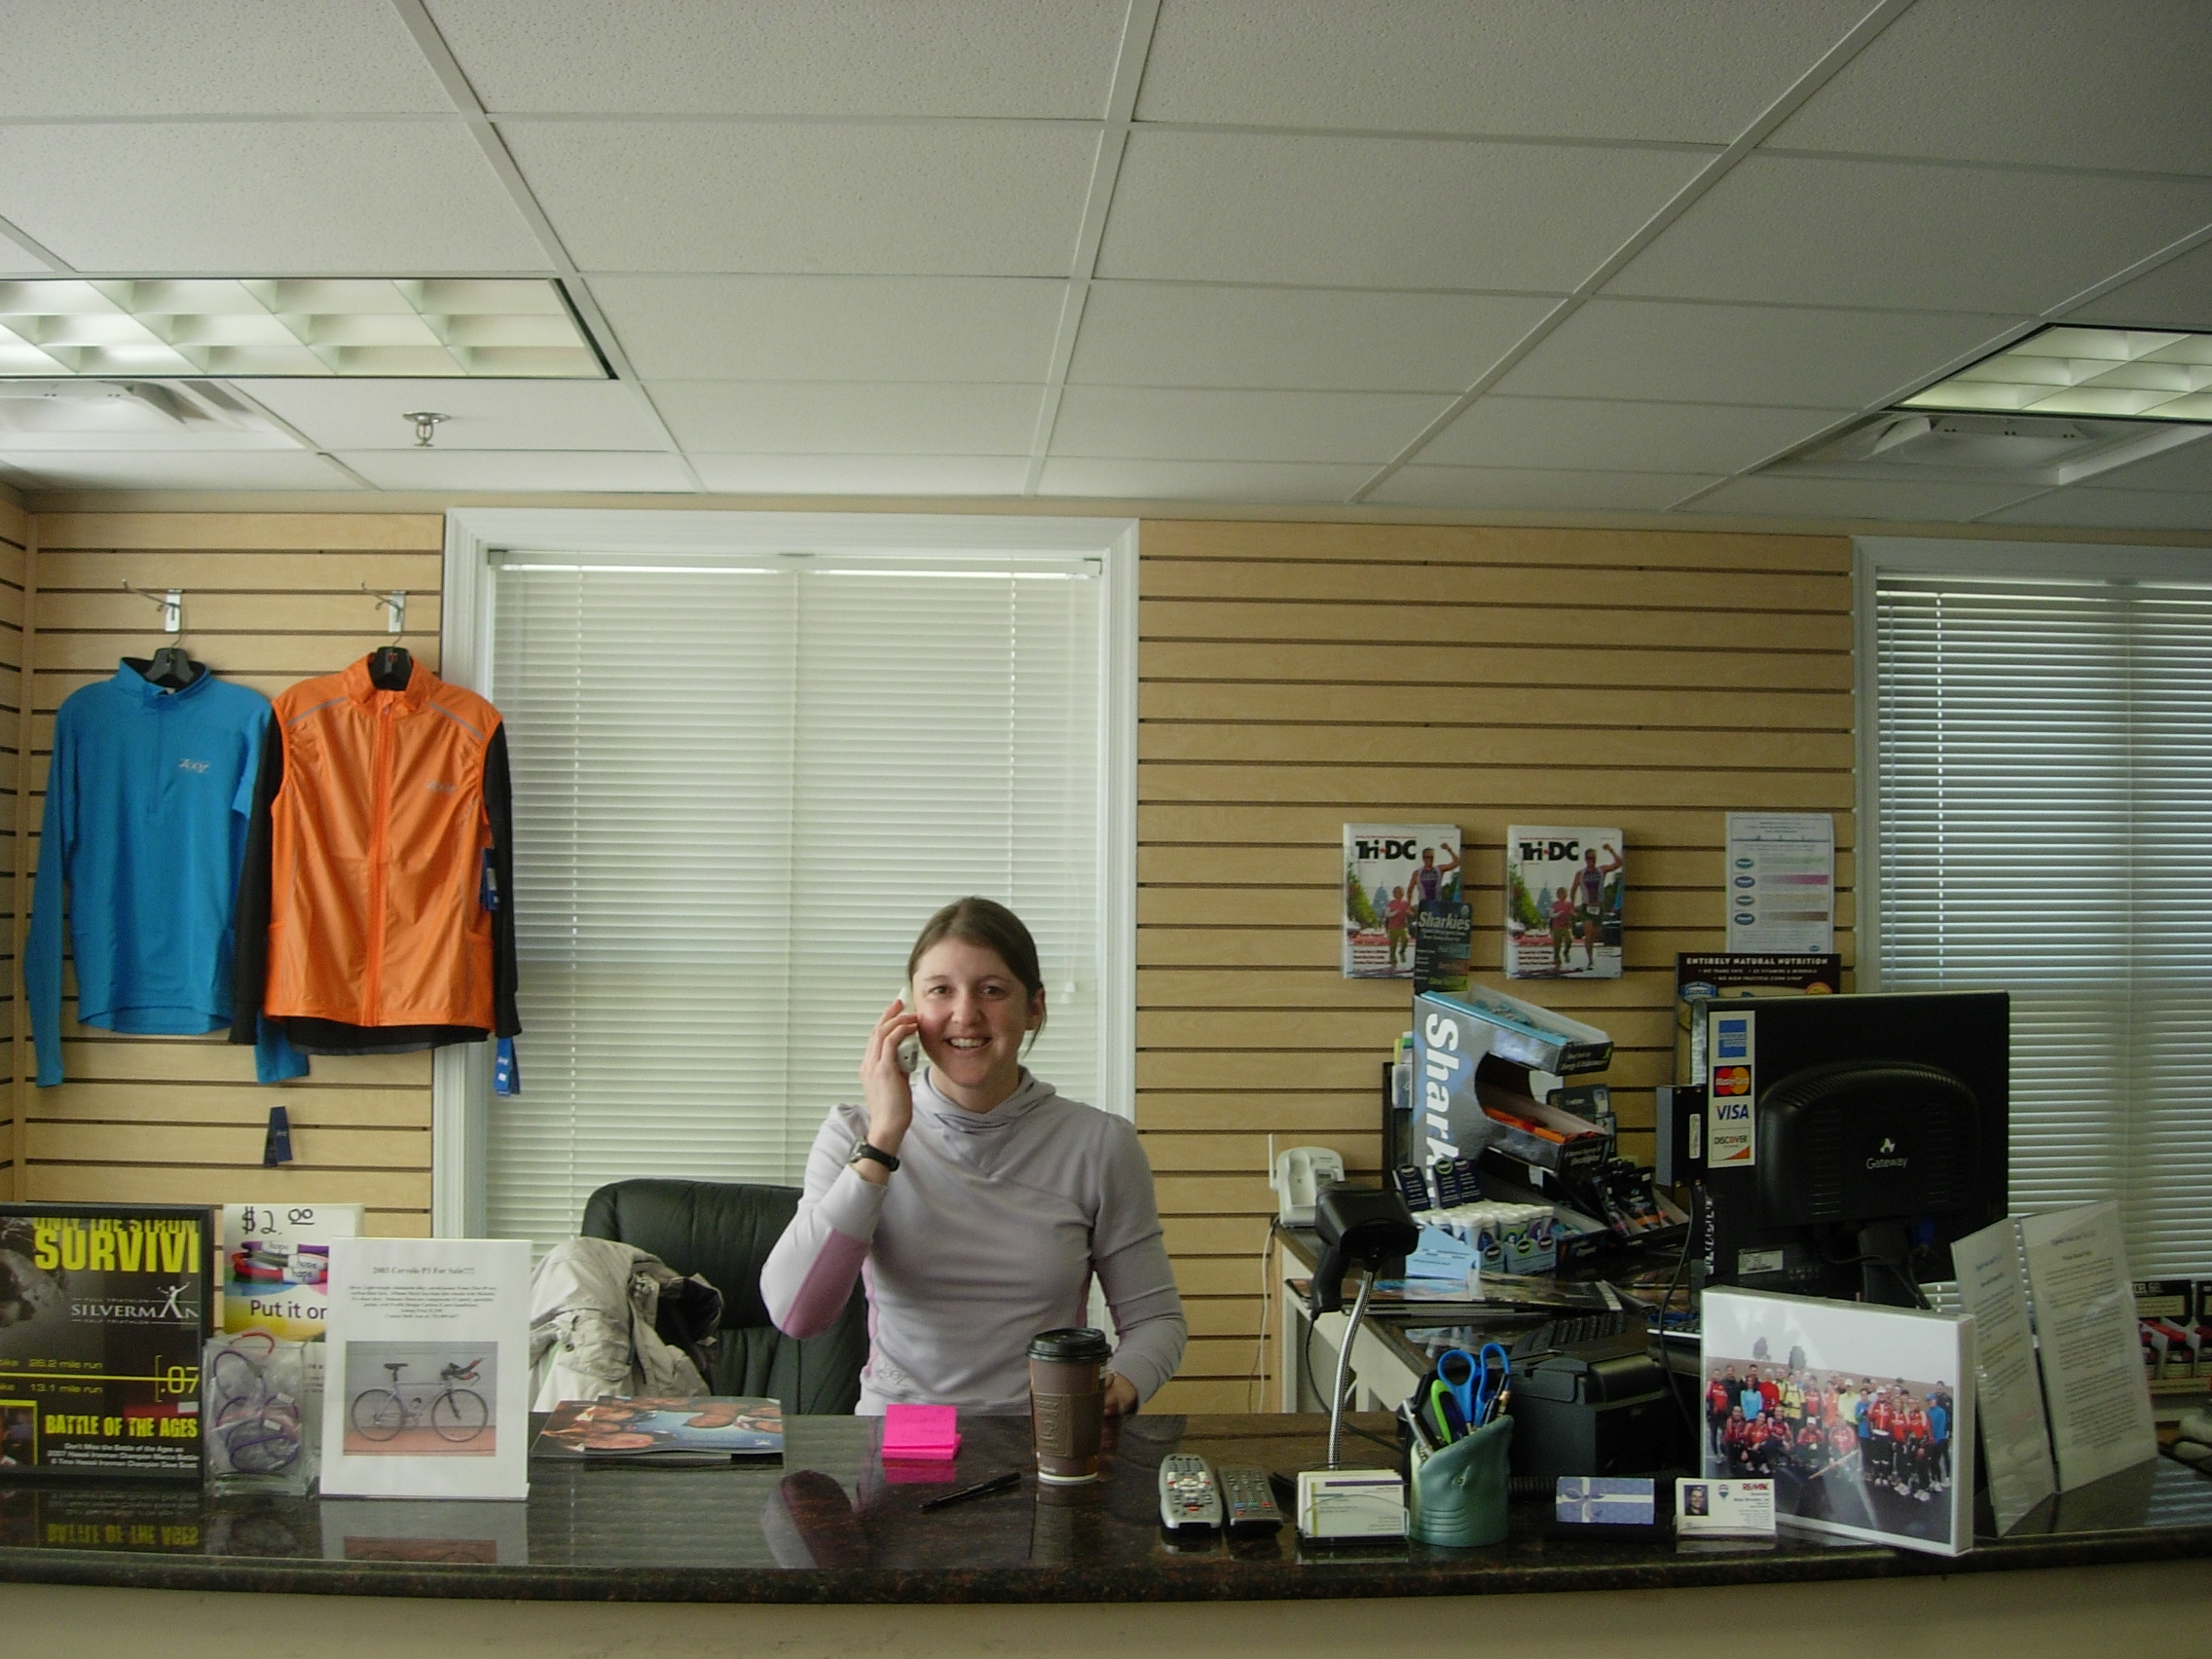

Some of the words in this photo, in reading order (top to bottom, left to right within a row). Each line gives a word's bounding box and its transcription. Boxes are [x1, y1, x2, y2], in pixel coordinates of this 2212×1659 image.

[1355, 839, 1379, 860] Tri
[1384, 839, 1417, 860] DC
[1519, 841, 1542, 861] Tri
[1548, 841, 1579, 861] DC
[1419, 911, 1470, 930] Sharkies
[1424, 1013, 1460, 1198] Shark
[1716, 1104, 1749, 1120] VISA
[1714, 1135, 1748, 1144] DISCOVER
[1865, 1158, 1908, 1169] Gateway
[250, 1300, 282, 1317] Put
[288, 1301, 301, 1318] it
[30, 1383, 55, 1392] 13.1
[45, 1415, 99, 1435] BATTLE
[103, 1416, 123, 1436] OF
[128, 1417, 155, 1437] THE
[159, 1418, 199, 1438] AGES
